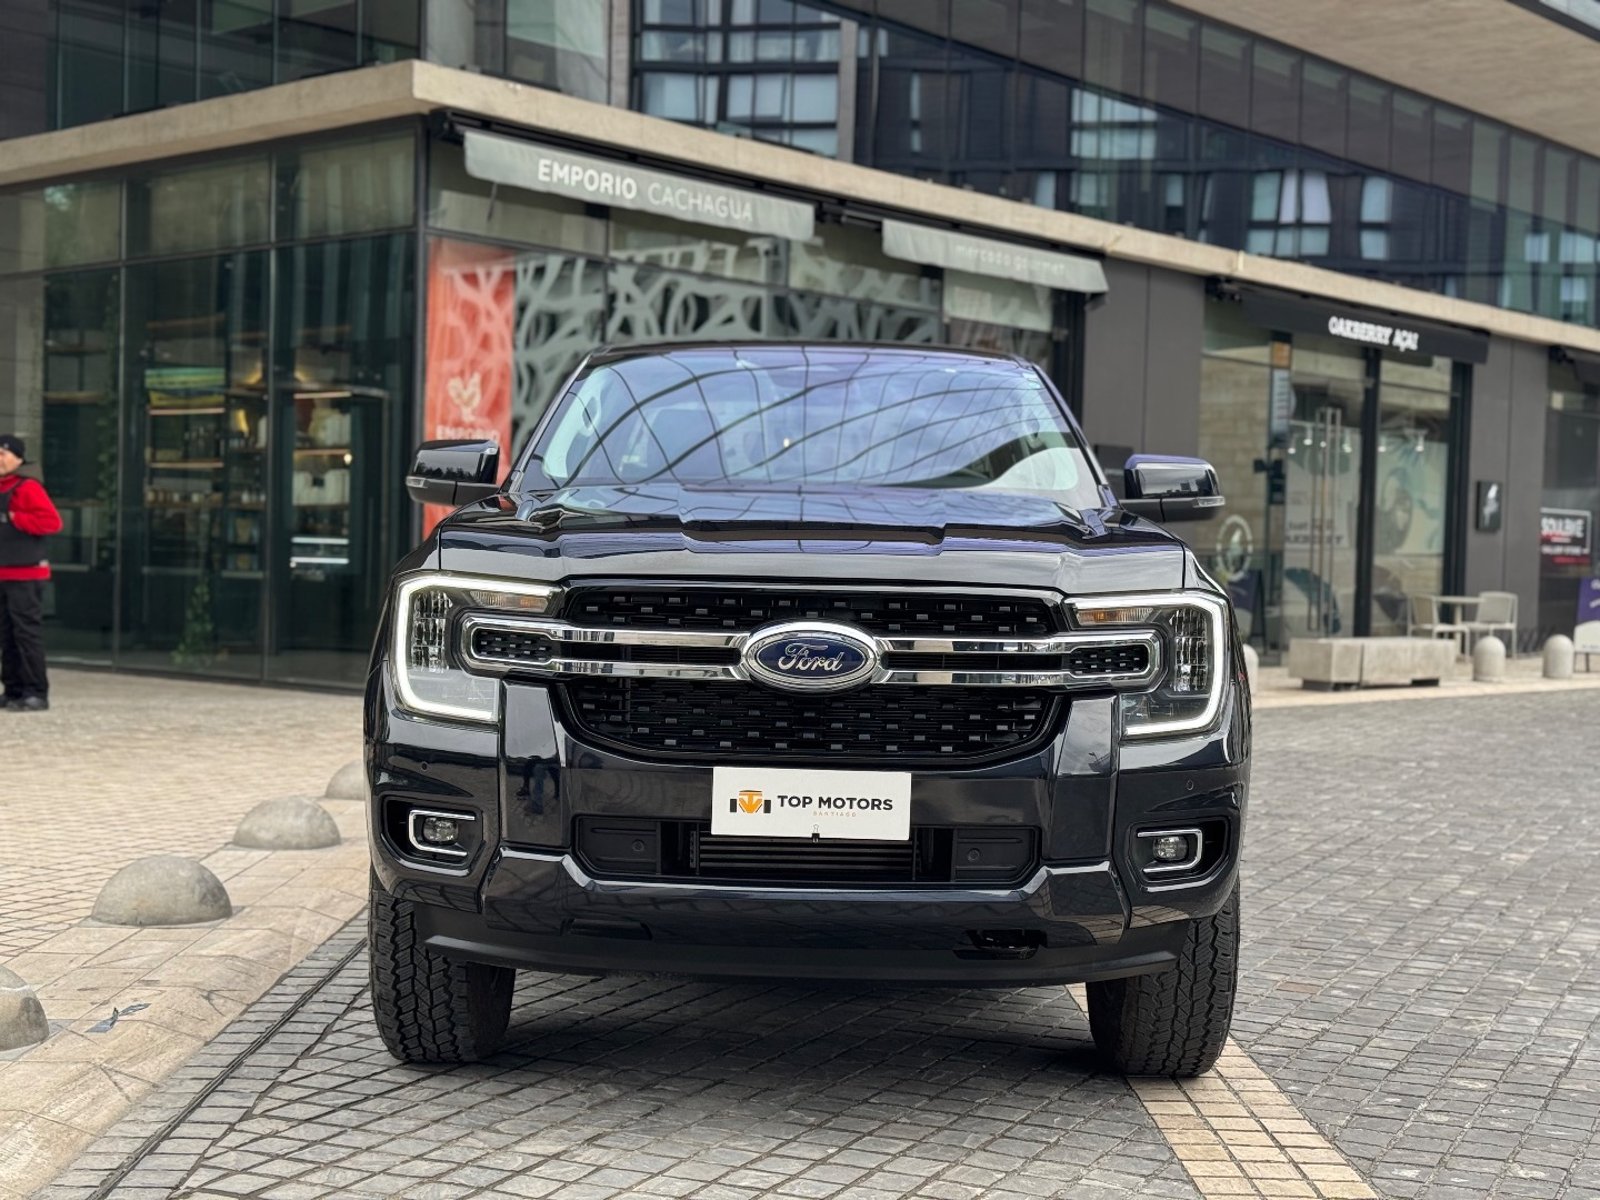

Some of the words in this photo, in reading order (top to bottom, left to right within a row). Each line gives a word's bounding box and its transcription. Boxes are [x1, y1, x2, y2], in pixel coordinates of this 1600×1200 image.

[537, 158, 638, 199] EMPORIO
[648, 183, 753, 221] CACHAGUA
[1328, 315, 1393, 346] OAKBERRY
[778, 643, 844, 671] Ford
[777, 795, 813, 808] TOP
[818, 796, 893, 811] MOTORS
[812, 810, 857, 818] SANTIAGO
